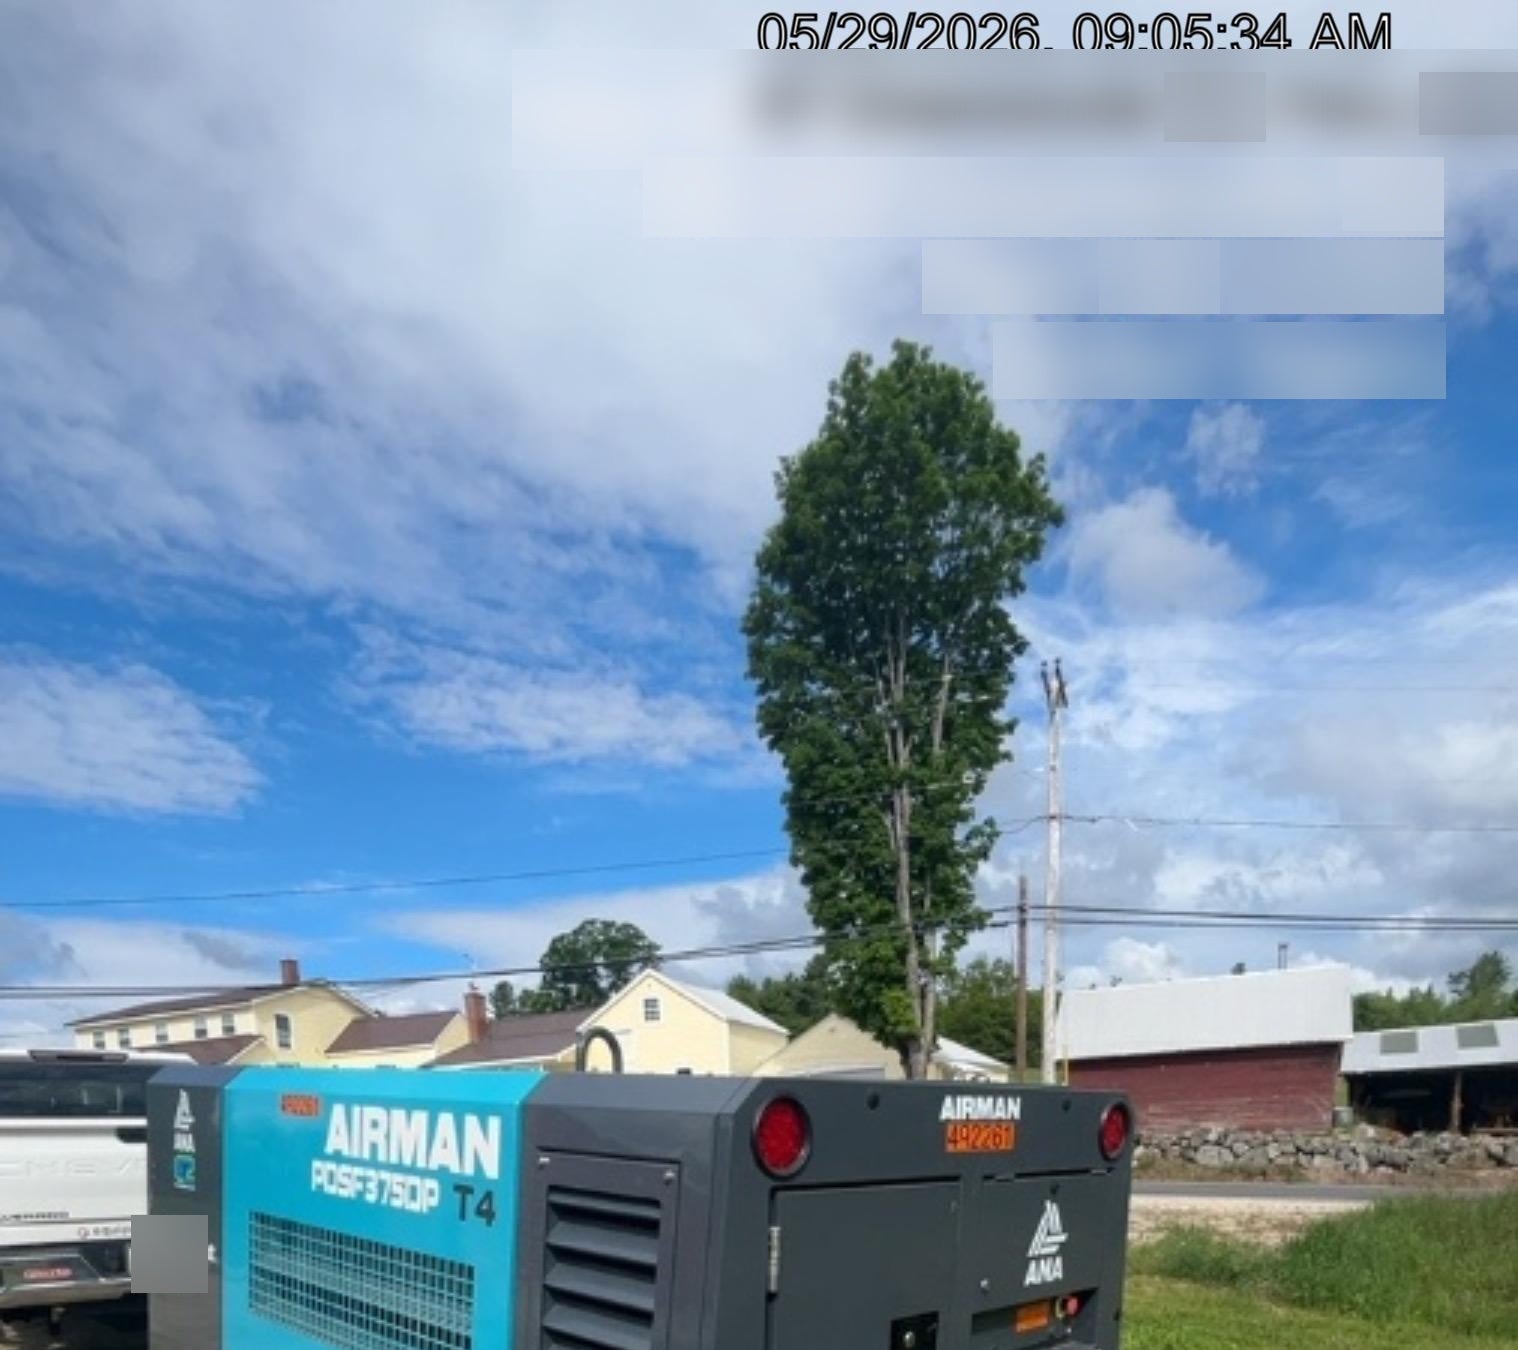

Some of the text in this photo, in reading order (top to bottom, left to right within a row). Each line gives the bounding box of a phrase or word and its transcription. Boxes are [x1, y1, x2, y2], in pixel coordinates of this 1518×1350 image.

[939, 1094, 1021, 1121] AIRMAN
[323, 1103, 502, 1180] AIRMAN
[453, 1183, 496, 1227] T4
[1023, 1255, 1064, 1287] ANA
